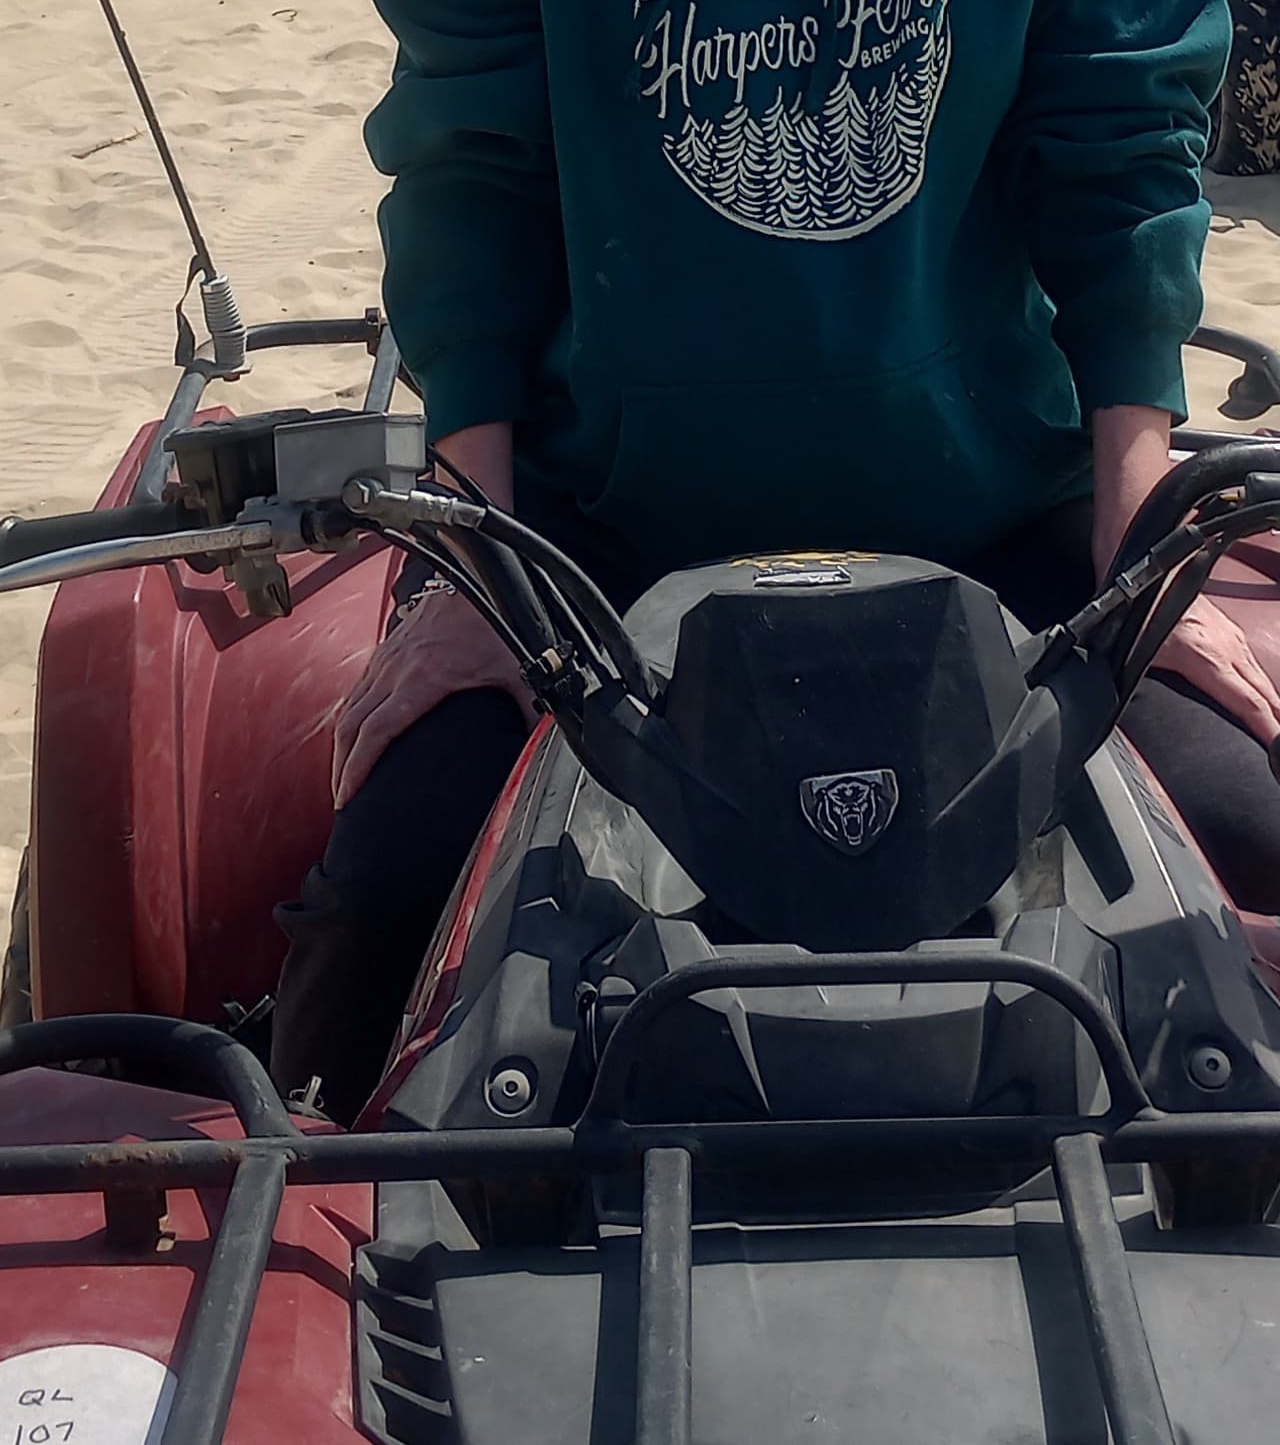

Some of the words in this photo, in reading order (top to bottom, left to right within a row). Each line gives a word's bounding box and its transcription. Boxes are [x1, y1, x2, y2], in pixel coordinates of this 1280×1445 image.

[635, 3, 820, 119] Harpers
[860, 18, 930, 68] BREWING
[18, 1388, 74, 1406] QL
[15, 1421, 74, 1445] 107
